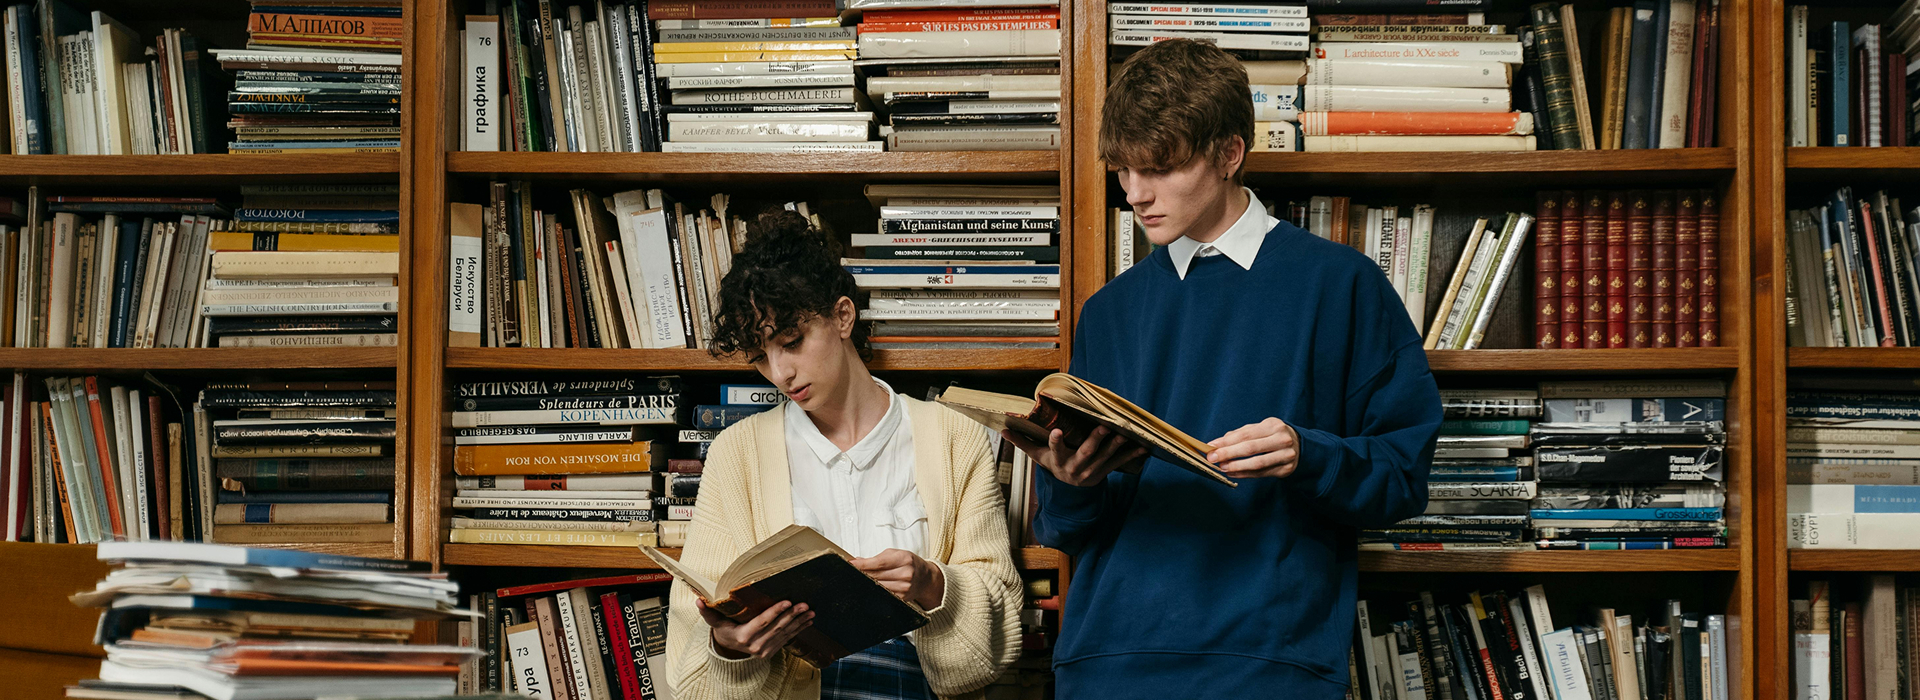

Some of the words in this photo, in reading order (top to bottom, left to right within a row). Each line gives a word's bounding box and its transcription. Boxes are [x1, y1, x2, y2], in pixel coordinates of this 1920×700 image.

[259, 14, 365, 34] М.АЛПАТОВ
[922, 23, 943, 32] SUR
[943, 23, 960, 32] LES
[961, 22, 977, 31] PAS
[979, 22, 995, 31] DES
[996, 21, 1050, 30] TEMPLIERS
[479, 37, 491, 46] 76
[573, 20, 587, 75] PORCELÁN
[1404, 48, 1414, 57] du
[1416, 48, 1436, 58] XXe
[1438, 48, 1459, 57] siècle
[679, 78, 712, 86] РУССКИЙ
[713, 78, 743, 86] ФАРФОР
[237, 94, 305, 102] PANKIEWICZ
[473, 66, 489, 133] графика
[580, 79, 592, 110] ČESKÝ
[244, 208, 305, 218] РОКОТОВ
[898, 219, 964, 233] Afghanistan
[967, 219, 988, 230] und
[991, 219, 1018, 230] seine
[1021, 219, 1053, 230] Kunst
[1380, 218, 1394, 249] HOME
[1421, 231, 1429, 268] structural
[1123, 248, 1131, 266] UND
[455, 258, 464, 311] Беларуси
[467, 256, 477, 314] Искусство
[1417, 269, 1426, 294] design
[210, 292, 271, 300] ZEICHNUNGEN
[662, 274, 675, 318] ИСКУССТВО
[228, 305, 244, 313] THE
[270, 336, 343, 346] ВЕНЕЦИАНОВ
[460, 381, 548, 396] VERSAILLES
[552, 380, 566, 391] de
[569, 379, 634, 391] Splendeurs
[539, 398, 604, 411] Splendeurs
[608, 398, 621, 408] de
[628, 395, 675, 408] PARIS
[560, 407, 667, 422] KOPENHAGEN
[1819, 407, 1861, 415] Städtebau
[1470, 420, 1503, 430] Varney
[460, 428, 515, 436] GEGENBILD
[558, 433, 594, 441] BILANG
[597, 433, 628, 441] KARLA
[1833, 434, 1897, 442] CONSTRUCTION
[505, 457, 530, 466] ROM
[533, 456, 556, 464] VON
[560, 454, 619, 464] MOSAIKEN
[622, 453, 641, 462] DIE
[1669, 456, 1695, 464] Pioniere
[1669, 464, 1680, 472] der
[1470, 483, 1529, 497] SCARPA
[489, 509, 509, 517] Loire
[510, 509, 518, 517] la
[520, 509, 530, 517] de
[531, 509, 568, 518] Châteaux
[569, 510, 612, 518] Merveilleux
[675, 508, 693, 518] Bau
[530, 521, 562, 529] CRANACH
[1793, 517, 1799, 526] OF
[1809, 515, 1819, 545] EGYPT
[478, 532, 514, 542] NAÏFS
[520, 532, 540, 542] LES
[549, 532, 560, 542] ET
[566, 532, 595, 543] CITÉ
[600, 533, 615, 543] LA
[579, 604, 591, 645] RAUMBILDUNG
[624, 605, 642, 648] France
[558, 596, 579, 664] PLAKATKUNST
[593, 612, 609, 655] ILE-DE-FRANCE
[612, 619, 622, 641] werde
[516, 647, 529, 657] 73
[633, 649, 645, 666] de
[623, 666, 631, 677] ich
[1515, 654, 1529, 680] Bach
[640, 667, 654, 696] Rois
